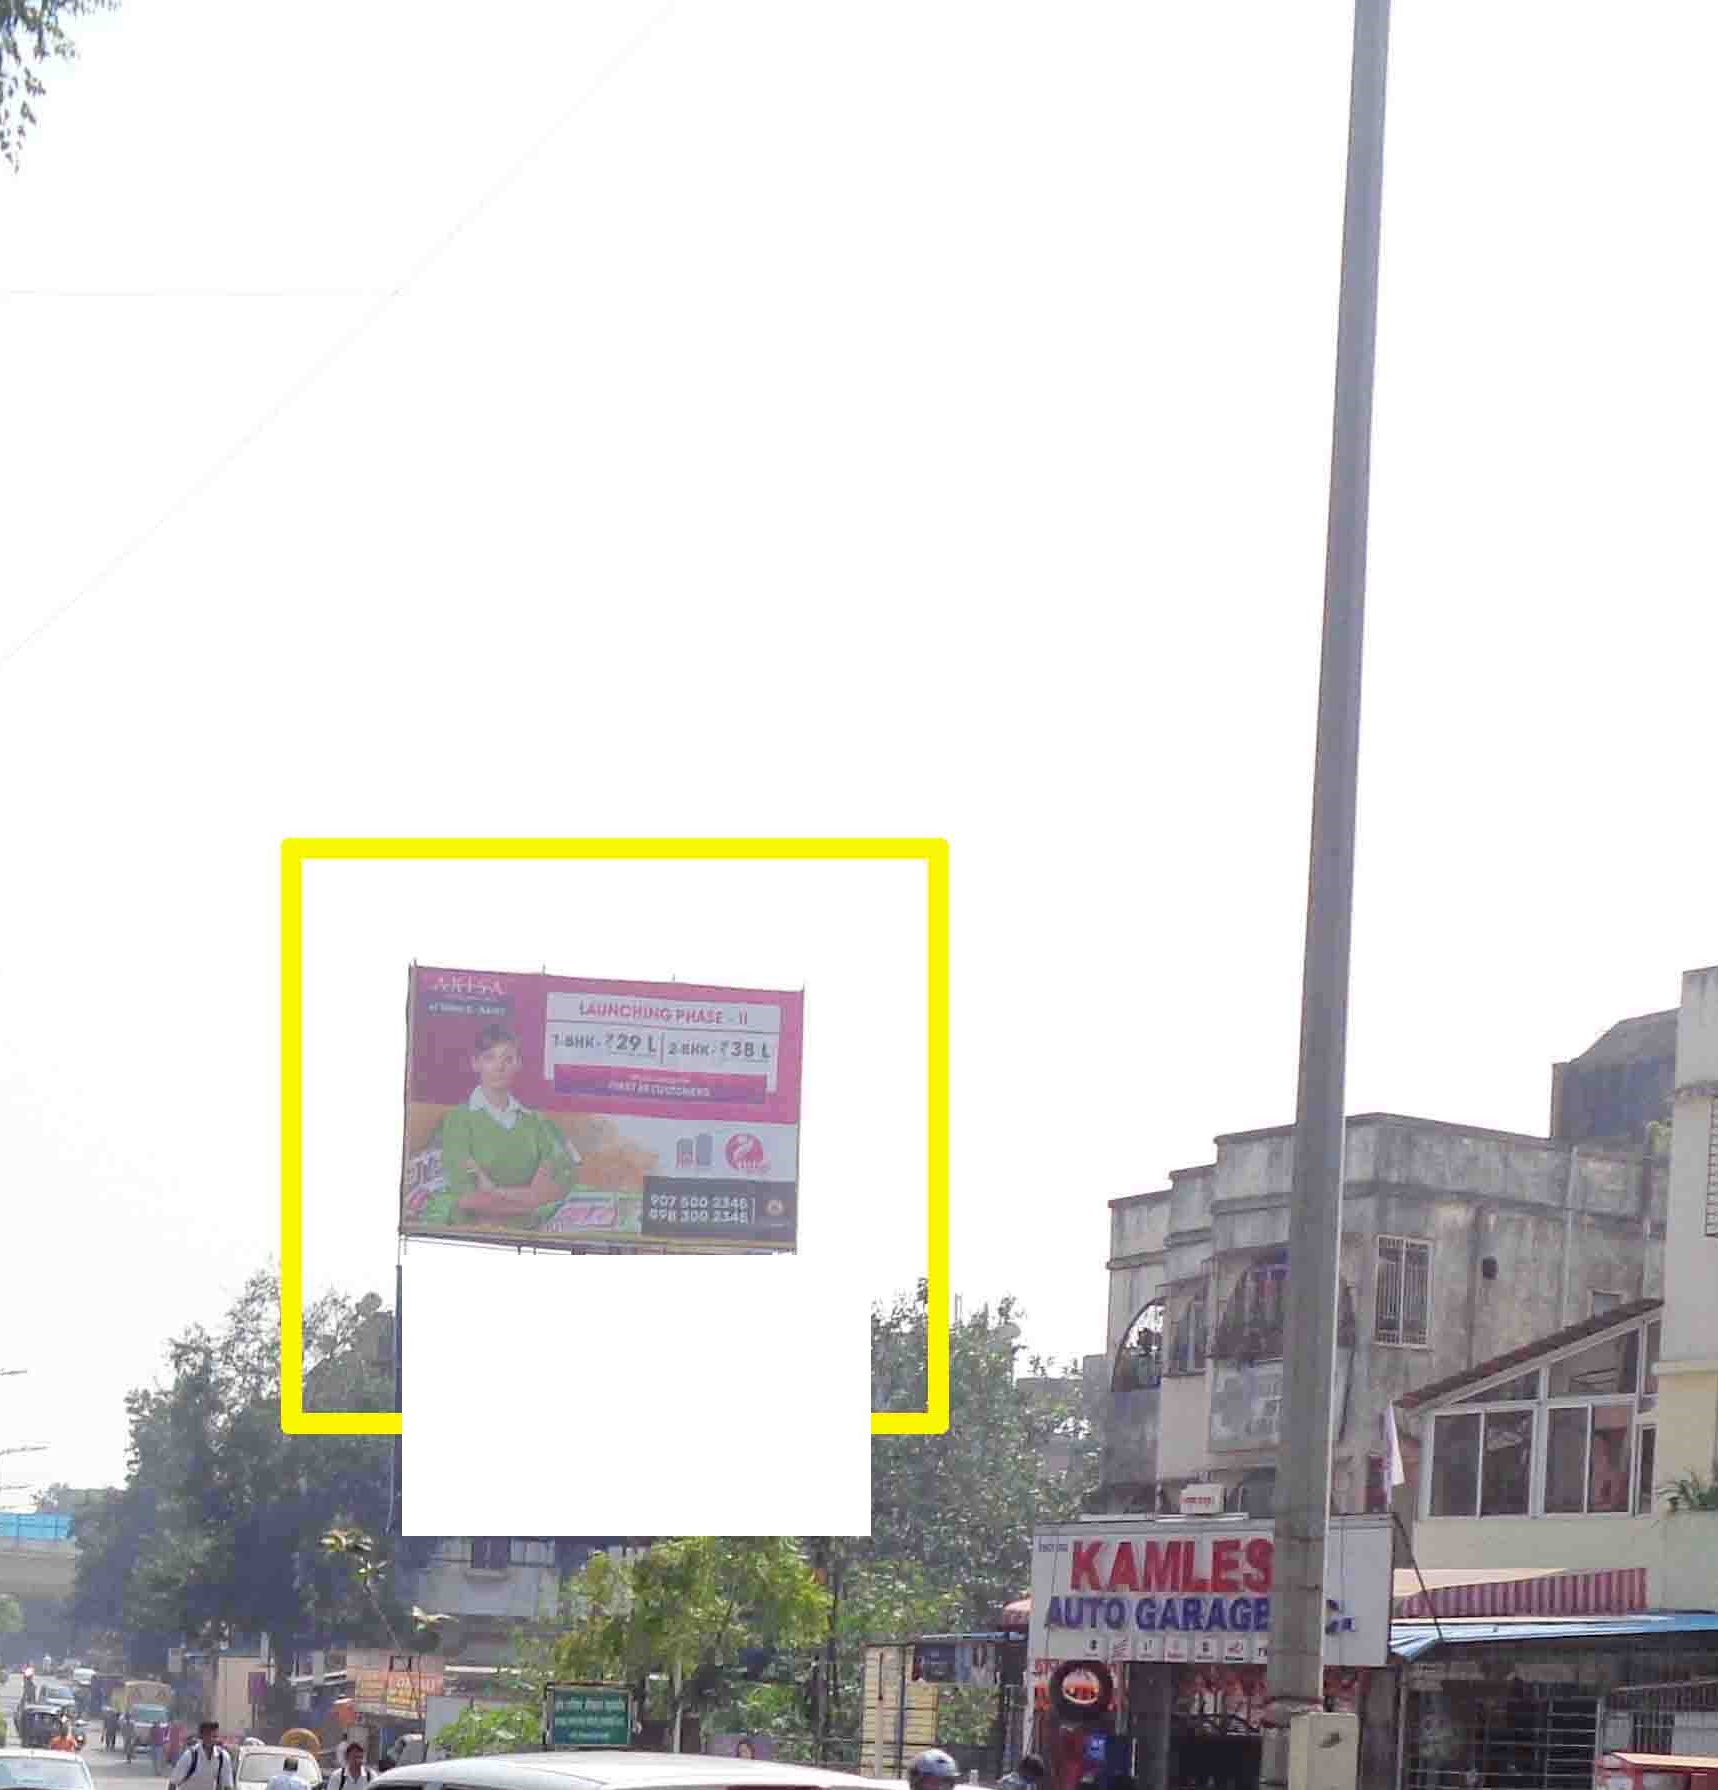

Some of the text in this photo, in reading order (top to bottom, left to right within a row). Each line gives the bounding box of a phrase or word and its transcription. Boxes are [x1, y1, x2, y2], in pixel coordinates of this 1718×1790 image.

[578, 1000, 672, 1022] LAUNCHING
[675, 1008, 724, 1025] PHASE
[1068, 1537, 1275, 1593] KAMLES
[1045, 1595, 1272, 1633] AUTO GARAGE
